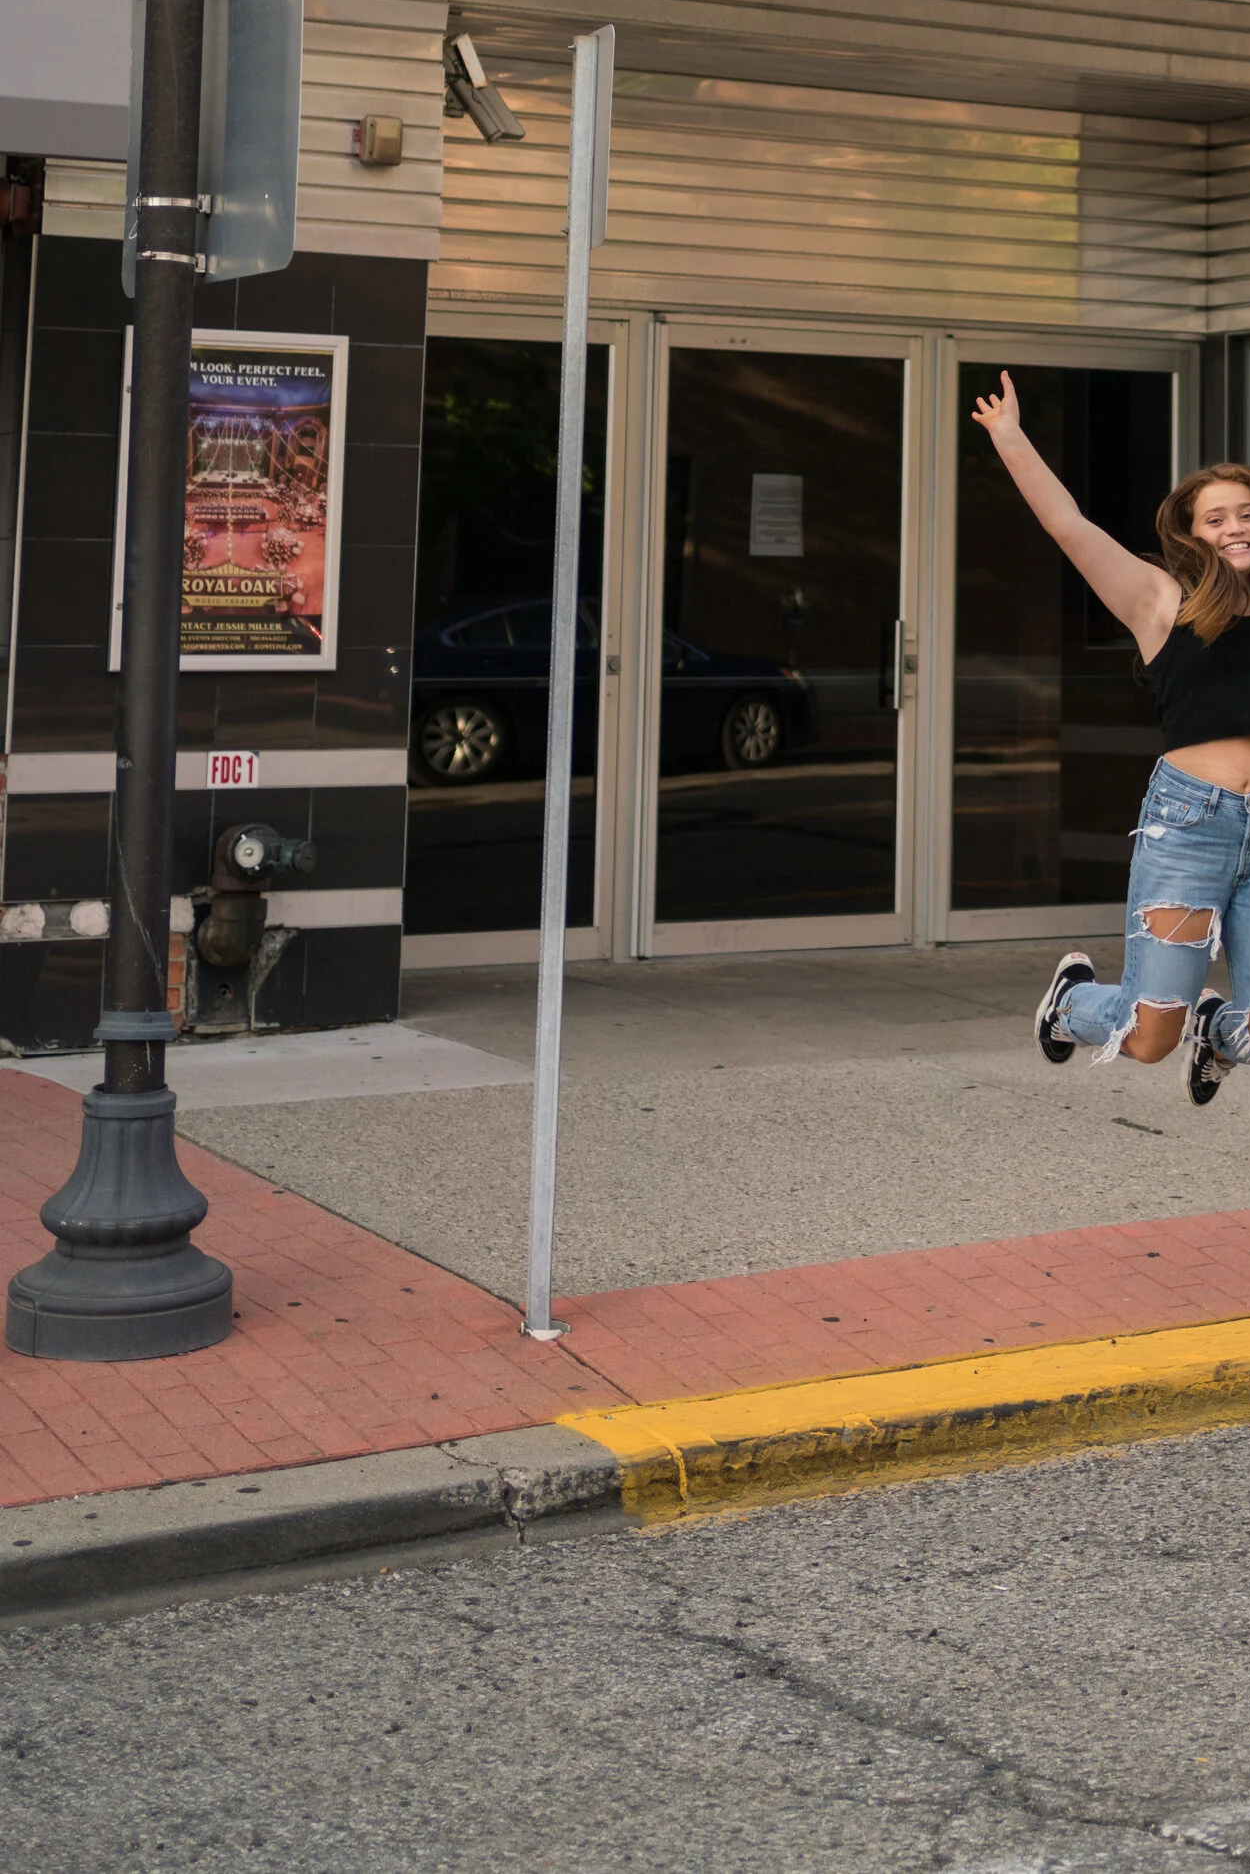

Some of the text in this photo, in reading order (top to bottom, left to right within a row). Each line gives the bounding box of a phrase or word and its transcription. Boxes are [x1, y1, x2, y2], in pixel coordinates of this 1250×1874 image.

[200, 362, 236, 374] LOOK.
[238, 364, 292, 376] PERFECT
[294, 367, 326, 378] FEEL.
[202, 374, 277, 387] YOUR EVENT.
[182, 578, 278, 594] ROYAL OAK
[181, 622, 283, 631] NTACT JESSIE MILLER
[211, 755, 254, 784] FDC 1
